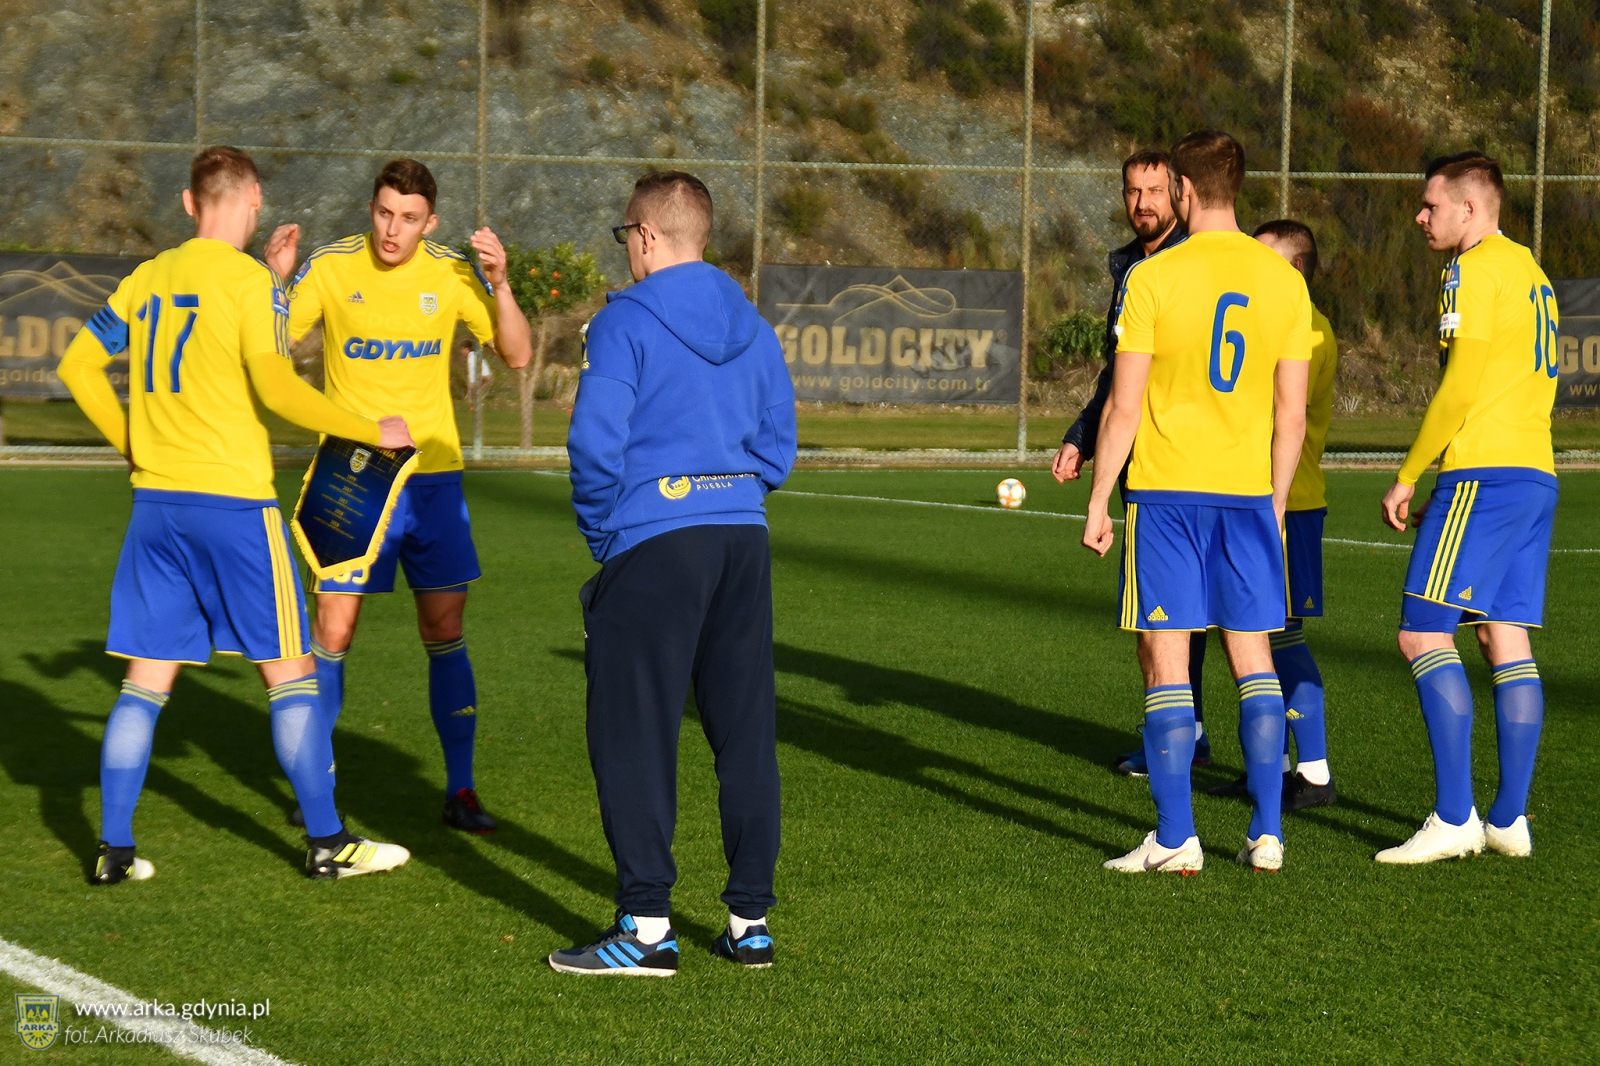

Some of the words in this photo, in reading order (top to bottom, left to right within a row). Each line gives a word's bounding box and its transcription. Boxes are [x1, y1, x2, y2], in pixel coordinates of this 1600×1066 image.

[135, 286, 200, 393] 17
[343, 336, 442, 361] GDYNIA
[774, 324, 994, 369] GOLDCITY
[1209, 291, 1250, 393] 6
[1529, 284, 1558, 378] 16
[696, 481, 733, 491] PUEBLA
